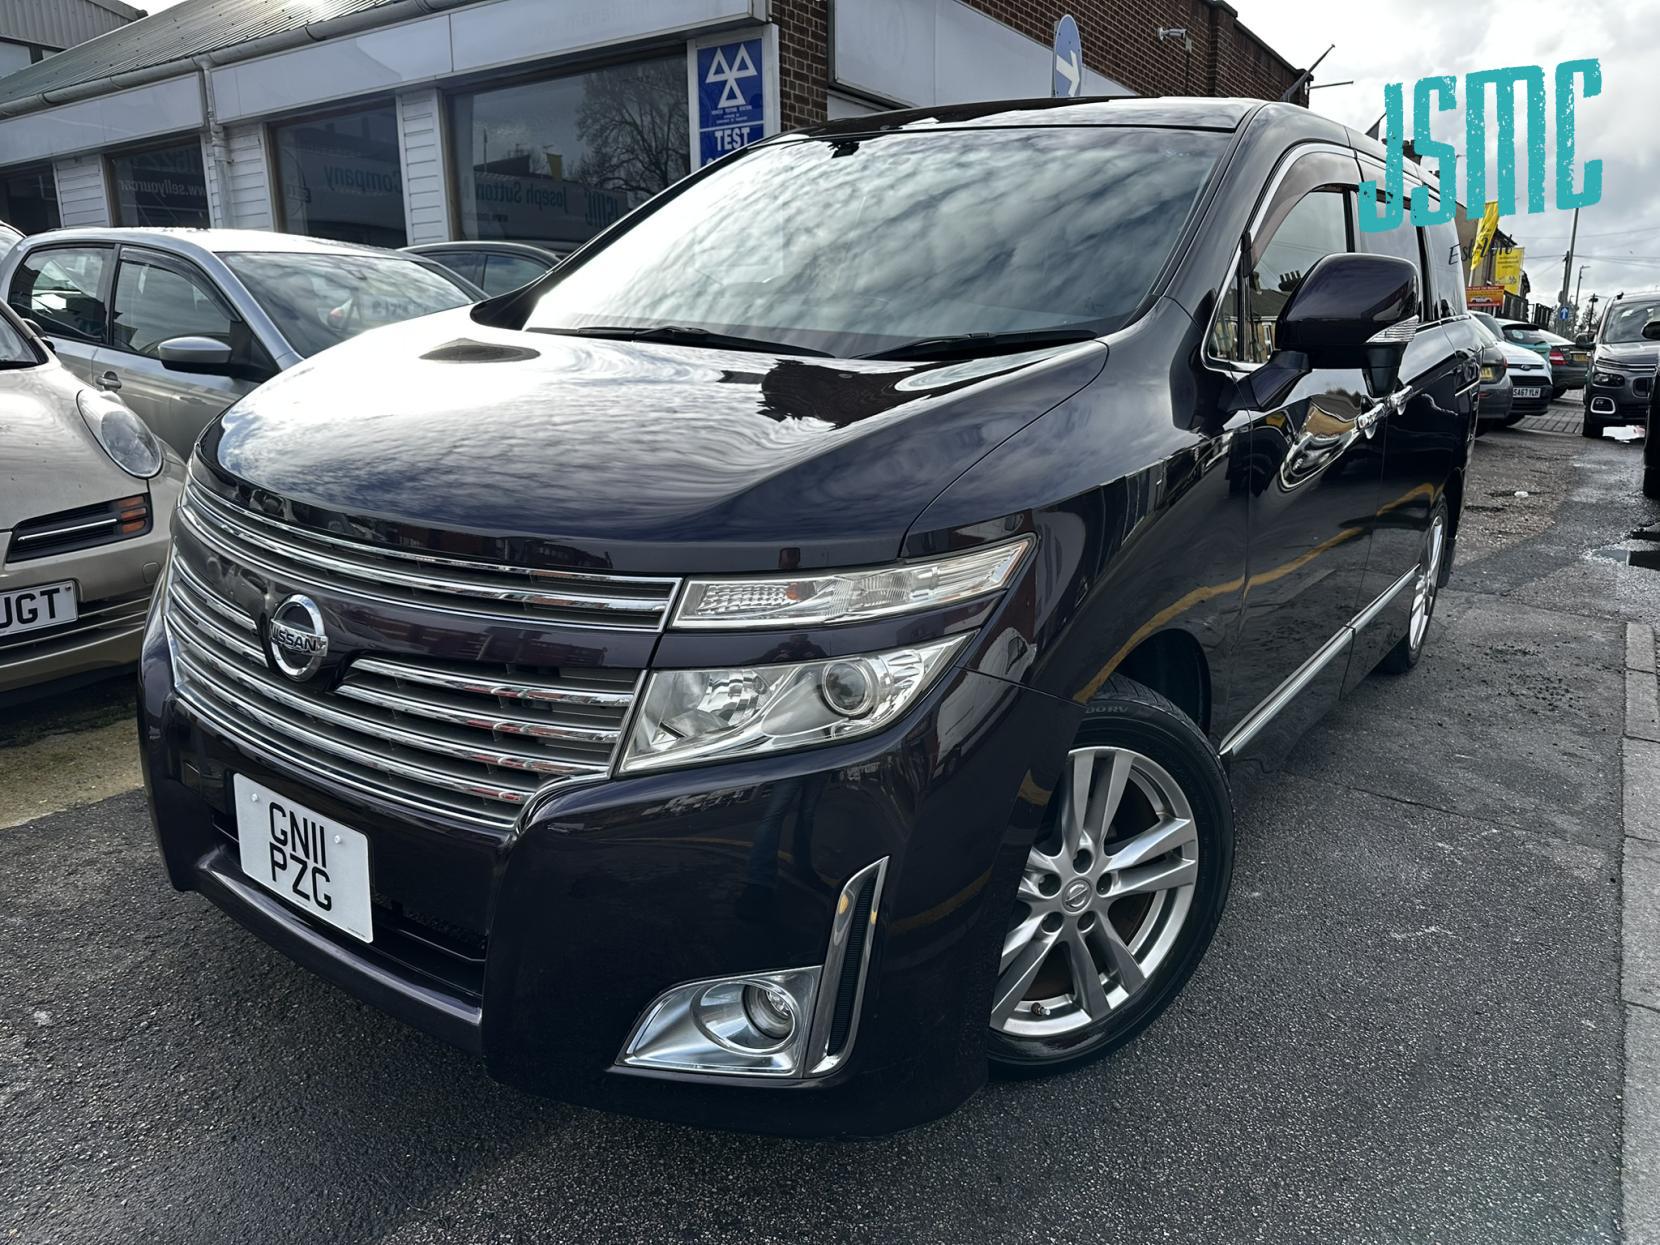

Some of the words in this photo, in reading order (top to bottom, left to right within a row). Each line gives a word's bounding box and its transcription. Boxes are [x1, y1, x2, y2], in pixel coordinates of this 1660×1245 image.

[714, 127, 751, 152] TEST
[269, 801, 327, 869] GN11
[269, 841, 332, 911] PZG
